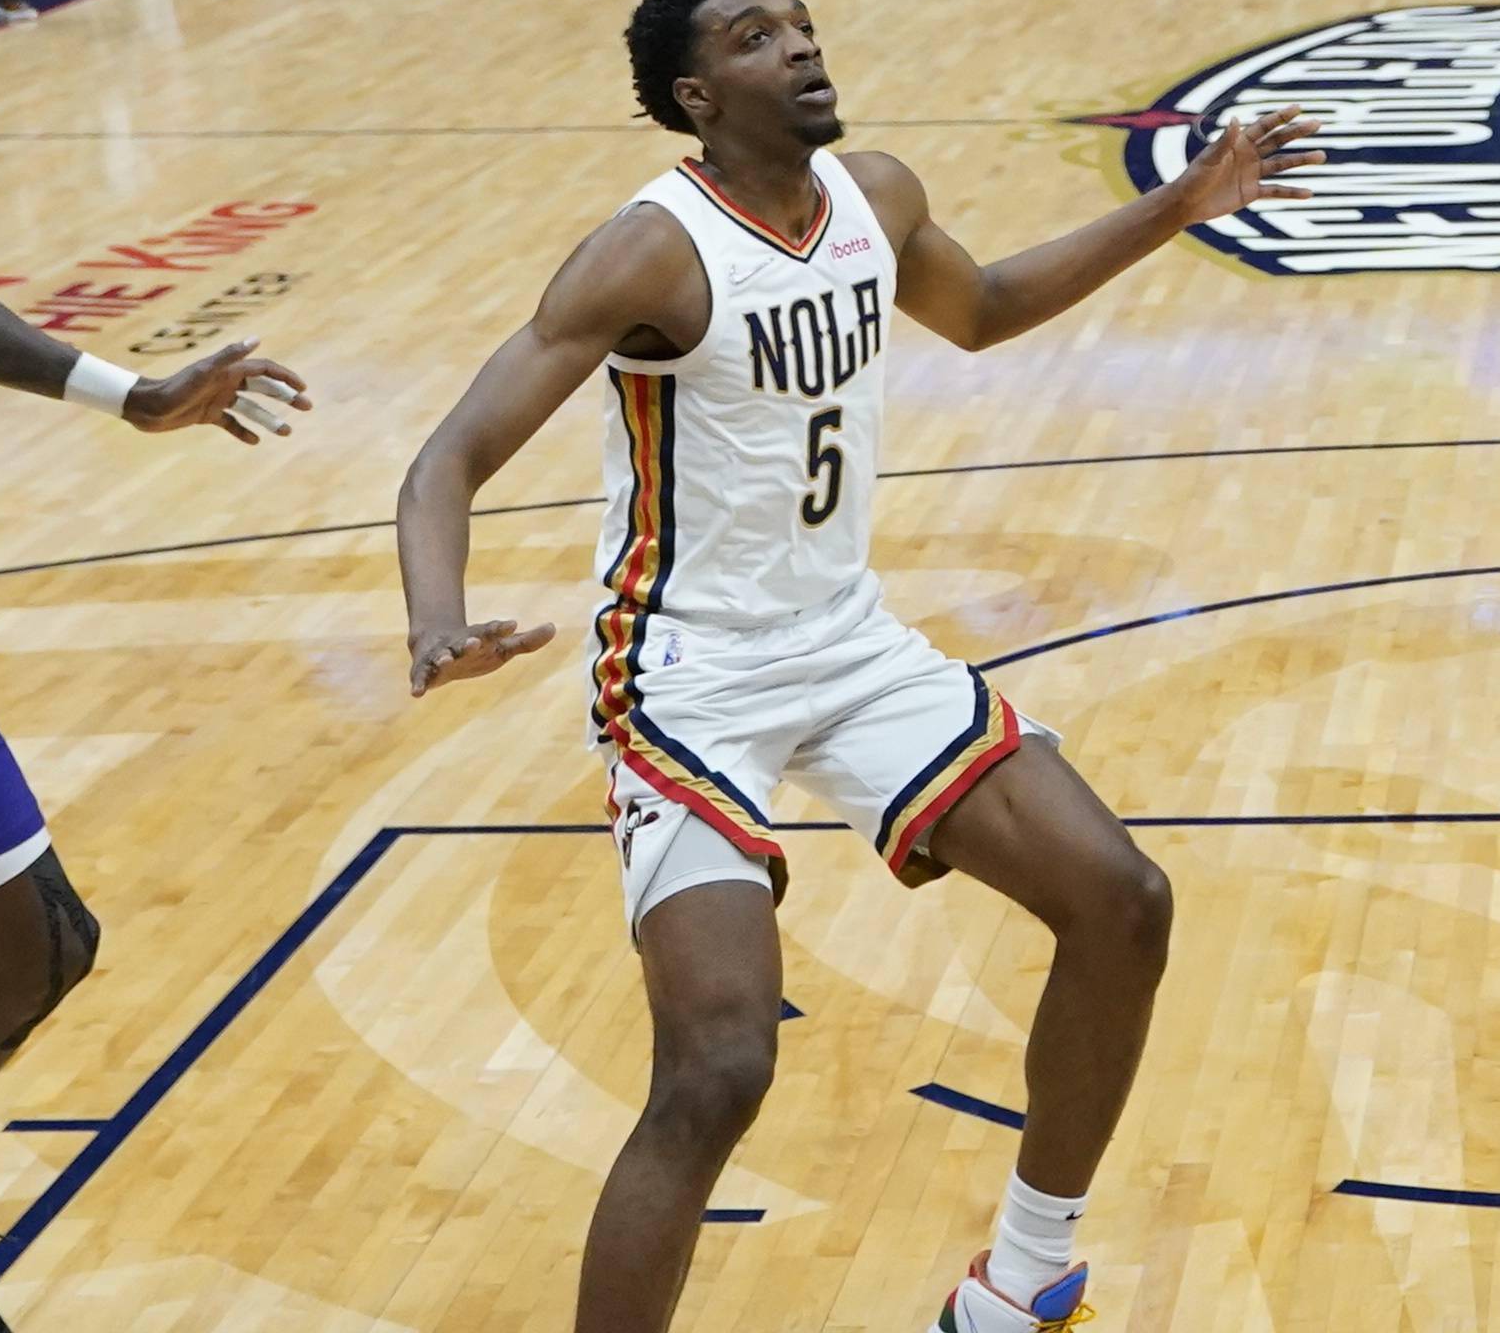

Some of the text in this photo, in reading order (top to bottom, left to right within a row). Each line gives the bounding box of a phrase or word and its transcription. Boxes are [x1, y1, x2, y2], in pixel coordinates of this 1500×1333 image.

[828, 235, 871, 261] ibotta
[743, 277, 882, 399] NOLA
[800, 404, 844, 531] 5
